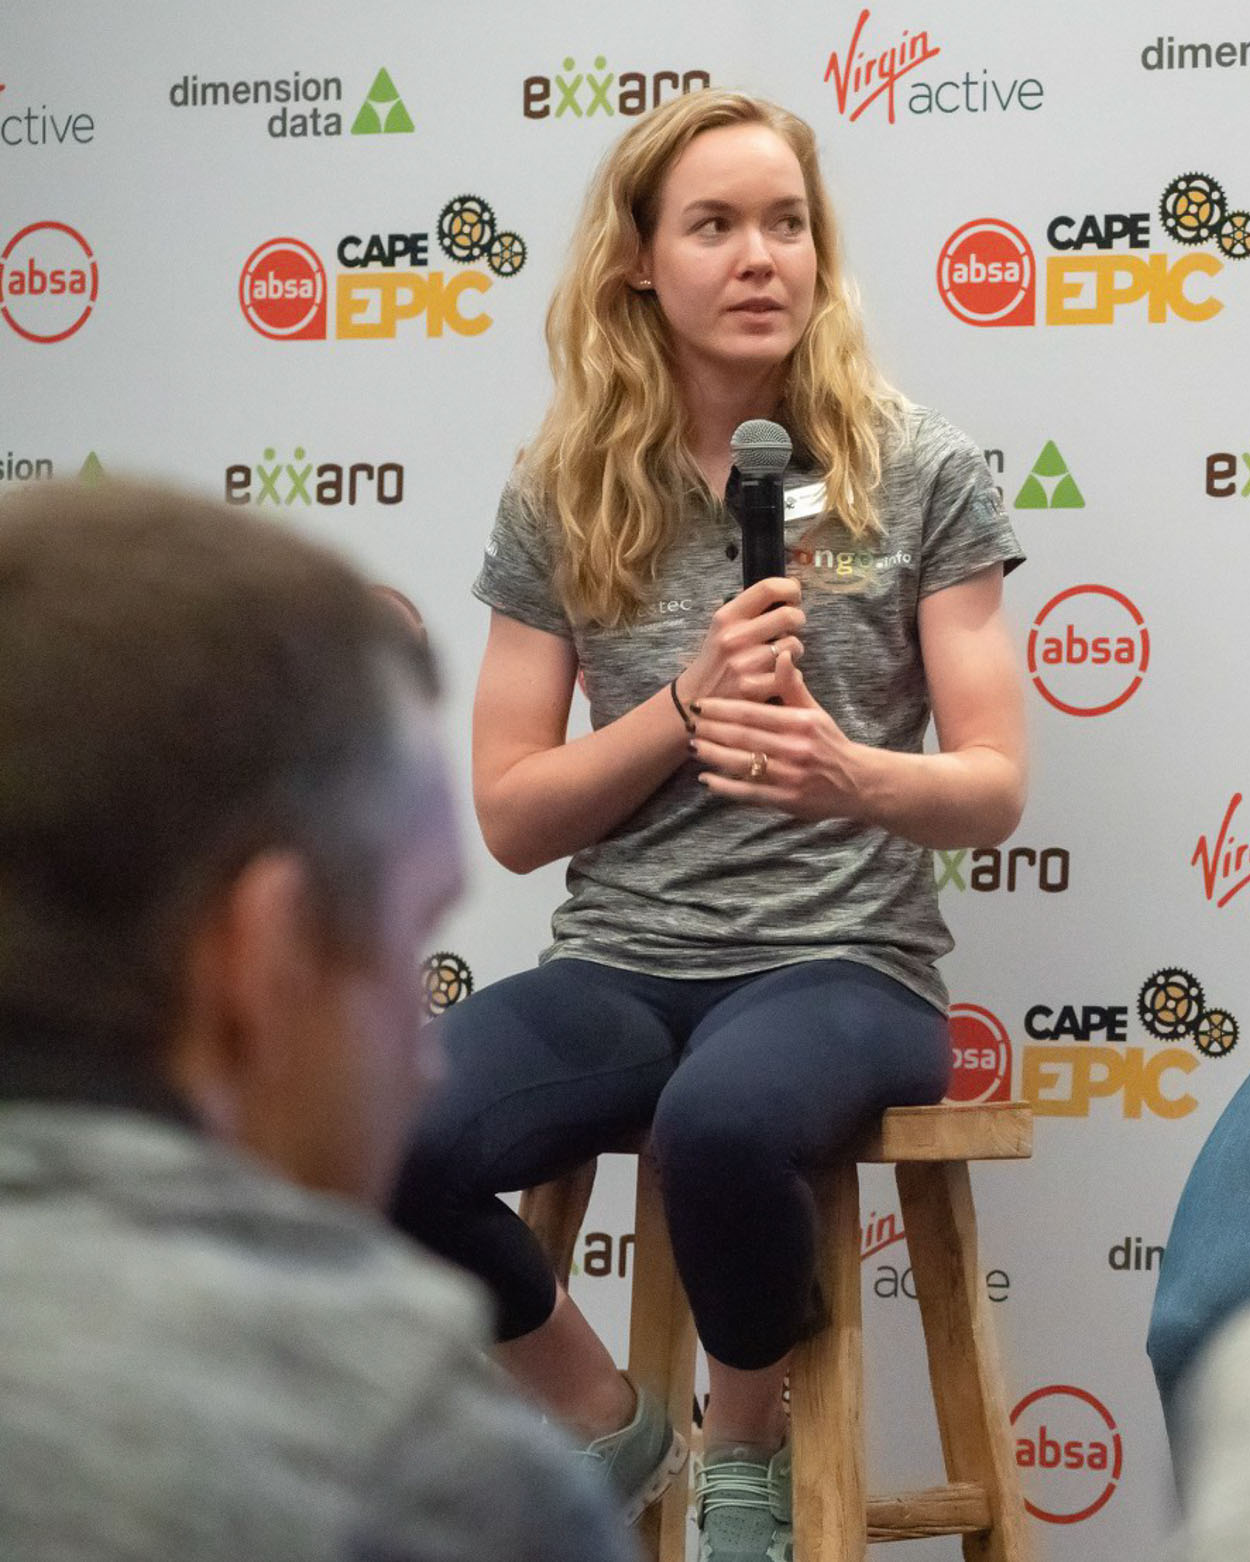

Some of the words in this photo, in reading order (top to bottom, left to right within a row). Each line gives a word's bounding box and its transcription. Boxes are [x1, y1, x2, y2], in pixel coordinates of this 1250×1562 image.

[824, 9, 940, 123] Virgin
[169, 71, 341, 107] dimension
[908, 70, 1044, 115] active
[268, 107, 341, 138] data
[337, 233, 428, 267] CAPE
[1047, 213, 1150, 250] CAPE
[8, 259, 86, 295] absa
[252, 272, 315, 300] absa
[952, 254, 1020, 285] absa
[335, 270, 493, 340] EPIC
[1046, 252, 1224, 326] EPIC
[225, 447, 404, 506] exxaro
[1042, 625, 1136, 665] absa
[1024, 1005, 1128, 1041] CAPE
[1022, 1046, 1200, 1119] EPIC
[1015, 1425, 1108, 1470] absa
